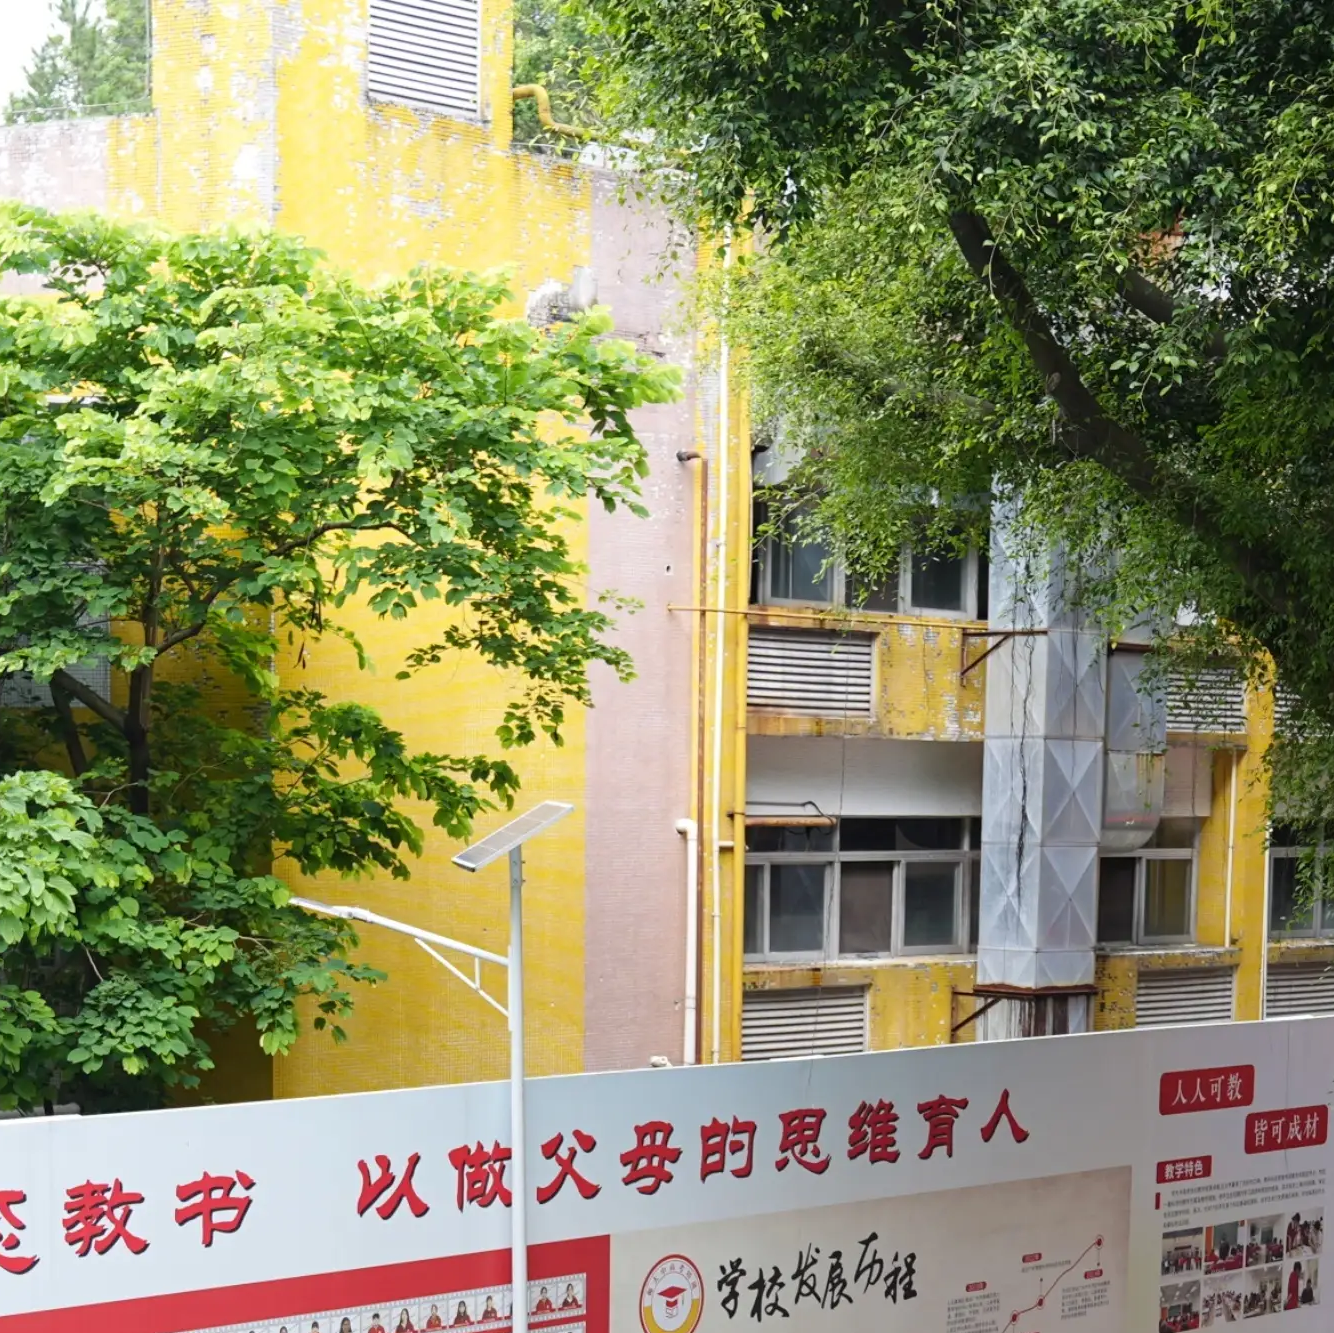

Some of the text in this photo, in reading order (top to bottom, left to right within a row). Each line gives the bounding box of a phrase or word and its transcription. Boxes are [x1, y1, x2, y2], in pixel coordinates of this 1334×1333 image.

[1171, 1073, 1243, 1105] 人人可教
[1254, 1112, 1319, 1147] 皆可成材
[357, 1088, 1029, 1218] 以做父母的思维育人
[1164, 1160, 1204, 1180] 教学特色
[717, 1231, 918, 1323] 学校发展历程
